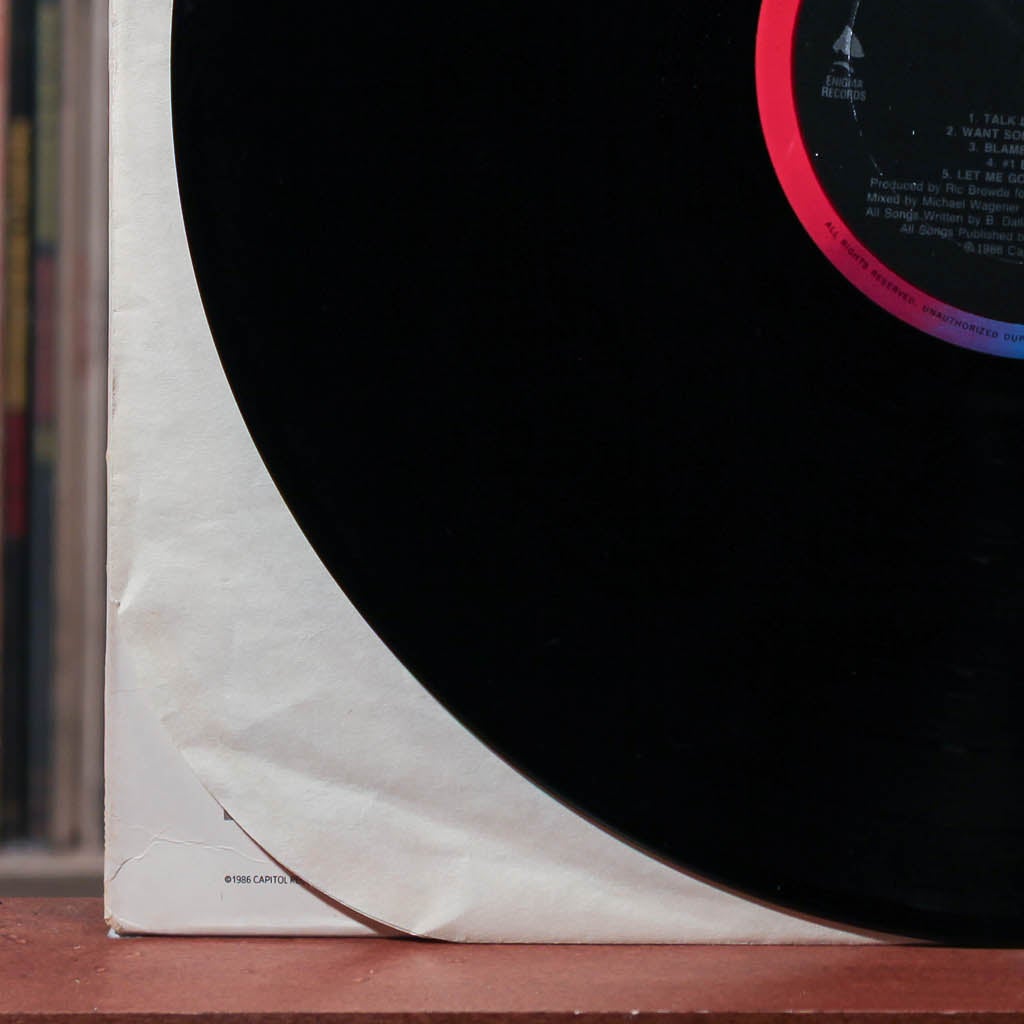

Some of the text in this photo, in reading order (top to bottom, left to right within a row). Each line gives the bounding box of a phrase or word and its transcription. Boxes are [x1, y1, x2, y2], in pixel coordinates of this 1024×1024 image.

[821, 86, 867, 102] RECORDS
[969, 113, 978, 124] 1.
[984, 113, 1017, 126] TALK
[945, 125, 957, 137] 2.
[961, 126, 1000, 140] WANT
[958, 169, 981, 182] LET
[985, 171, 1003, 184] ME
[870, 178, 923, 194] Produced
[927, 182, 940, 195] by
[946, 182, 964, 195] Ric
[866, 192, 900, 205] Mixed
[904, 195, 917, 208] by
[922, 196, 966, 210] Michael
[970, 199, 1019, 214] Wagener
[865, 207, 880, 217] All
[884, 207, 919, 222] Songs
[923, 210, 964, 224] Written
[968, 213, 981, 226] by
[899, 223, 914, 234] All
[919, 224, 954, 239] Songs
[958, 227, 1013, 241] Published
[823, 219, 842, 239] ALL
[838, 237, 870, 270] RIGHTS
[919, 303, 999, 338] UNAUTHORIZED
[253, 875, 288, 885] CAPITOL
